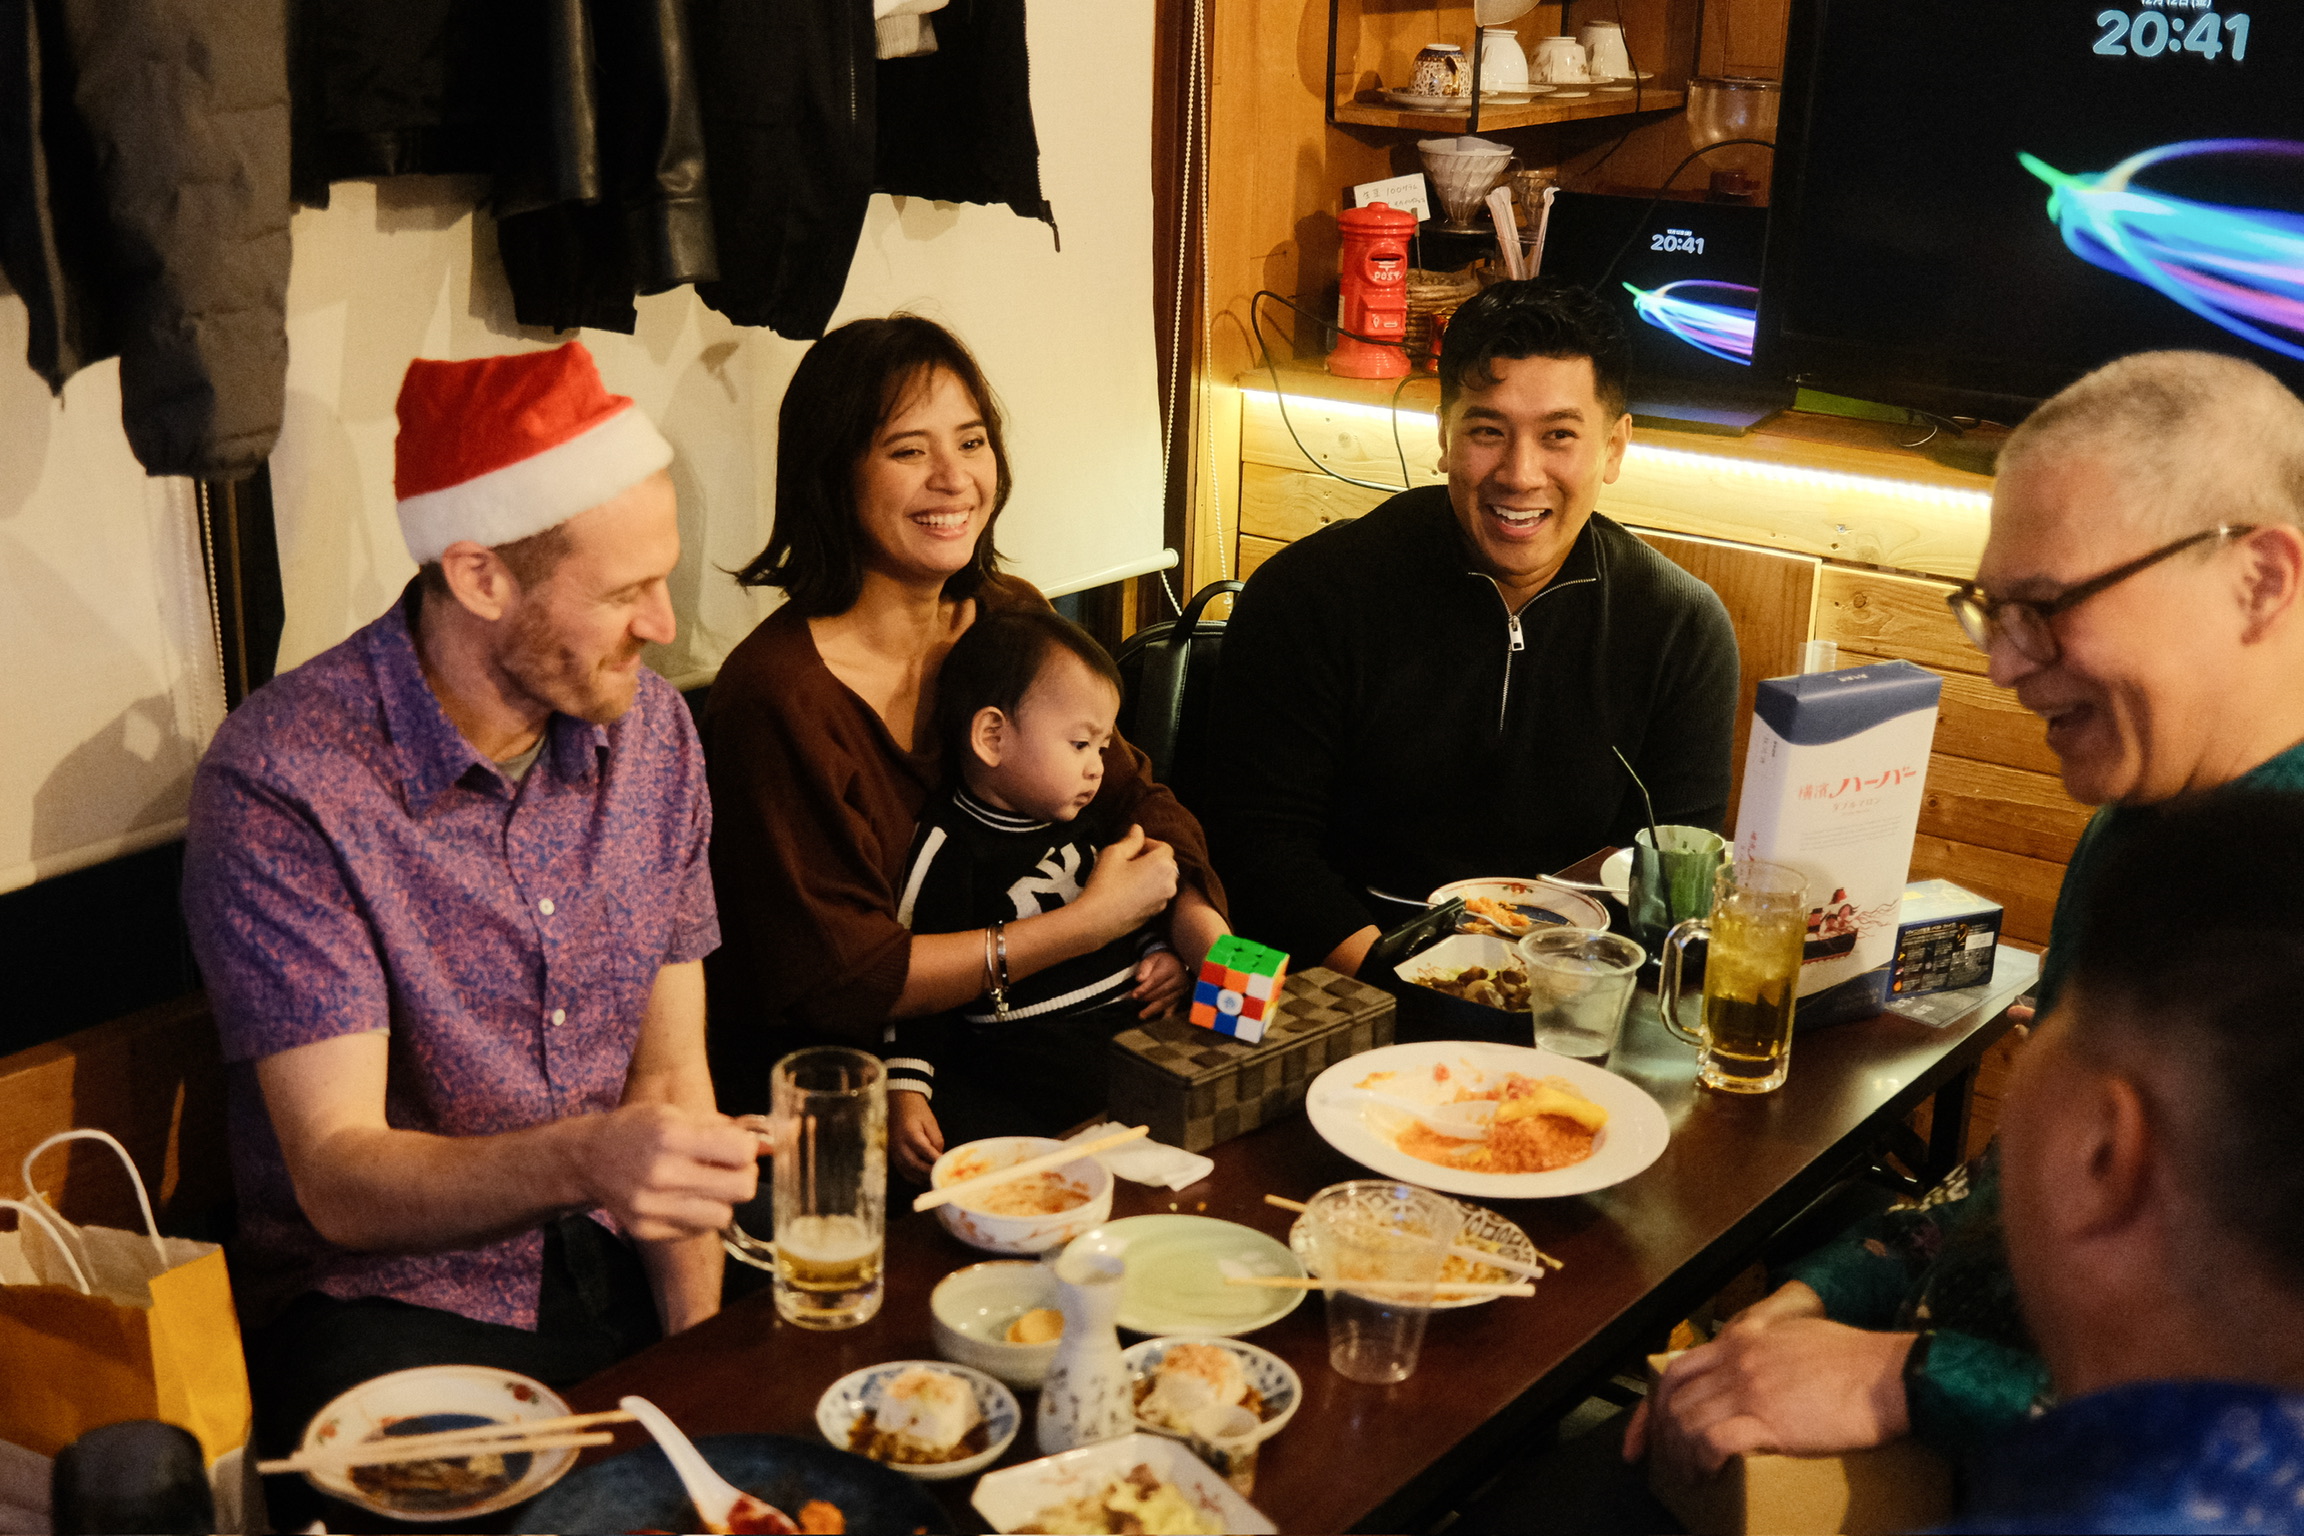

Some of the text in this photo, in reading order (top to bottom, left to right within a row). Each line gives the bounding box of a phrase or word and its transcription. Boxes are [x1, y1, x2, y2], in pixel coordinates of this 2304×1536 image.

[2092, 9, 2250, 61] 20:41
[1650, 233, 1705, 256] 20:41
[1373, 271, 1401, 282] POST
